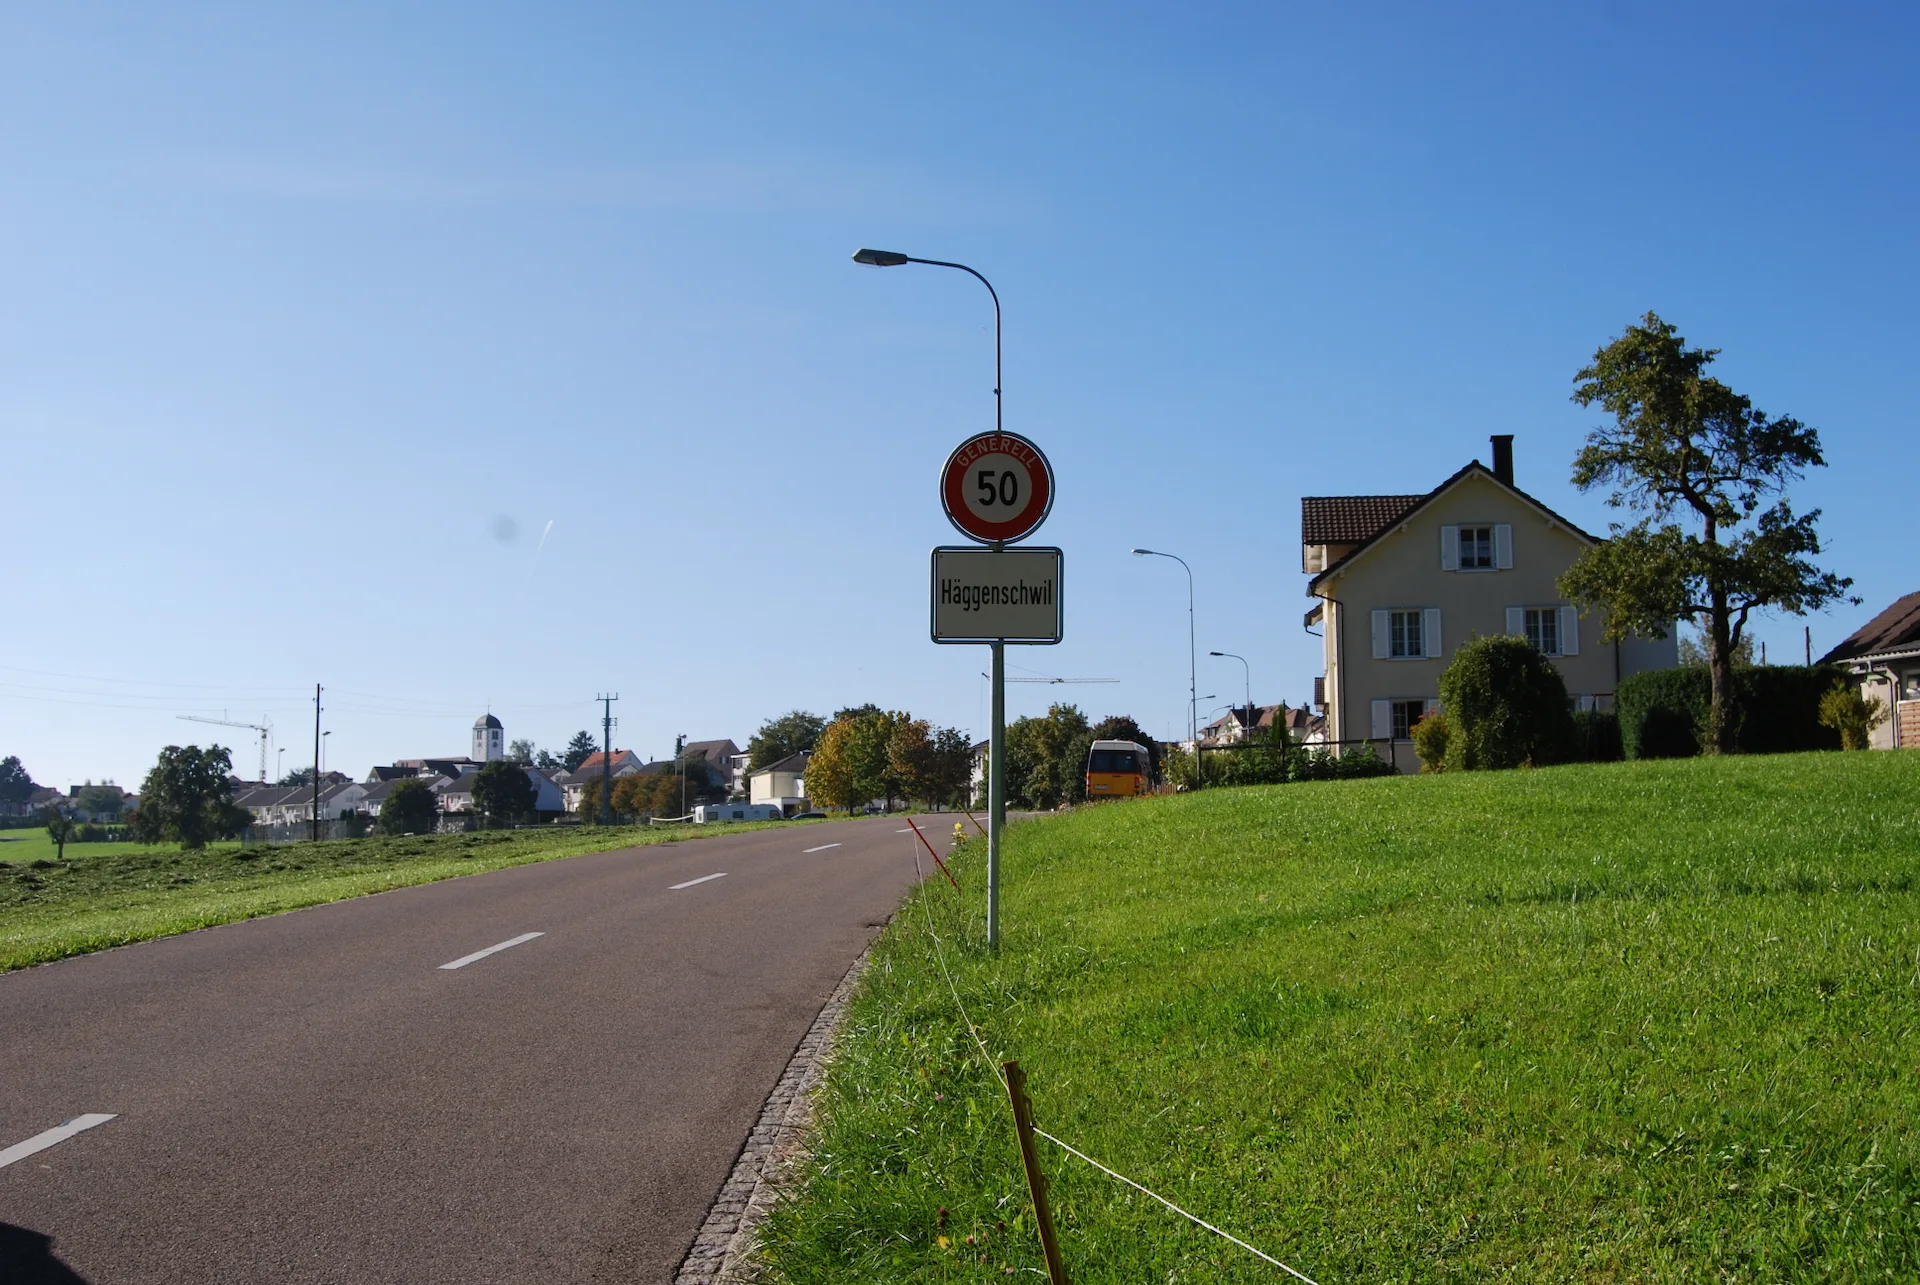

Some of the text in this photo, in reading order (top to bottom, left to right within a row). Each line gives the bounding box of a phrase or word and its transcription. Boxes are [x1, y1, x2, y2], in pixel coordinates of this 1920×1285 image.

[956, 438, 1039, 469] GENERELL
[978, 470, 1018, 506] 50
[941, 579, 1052, 611] Häggenschwil
